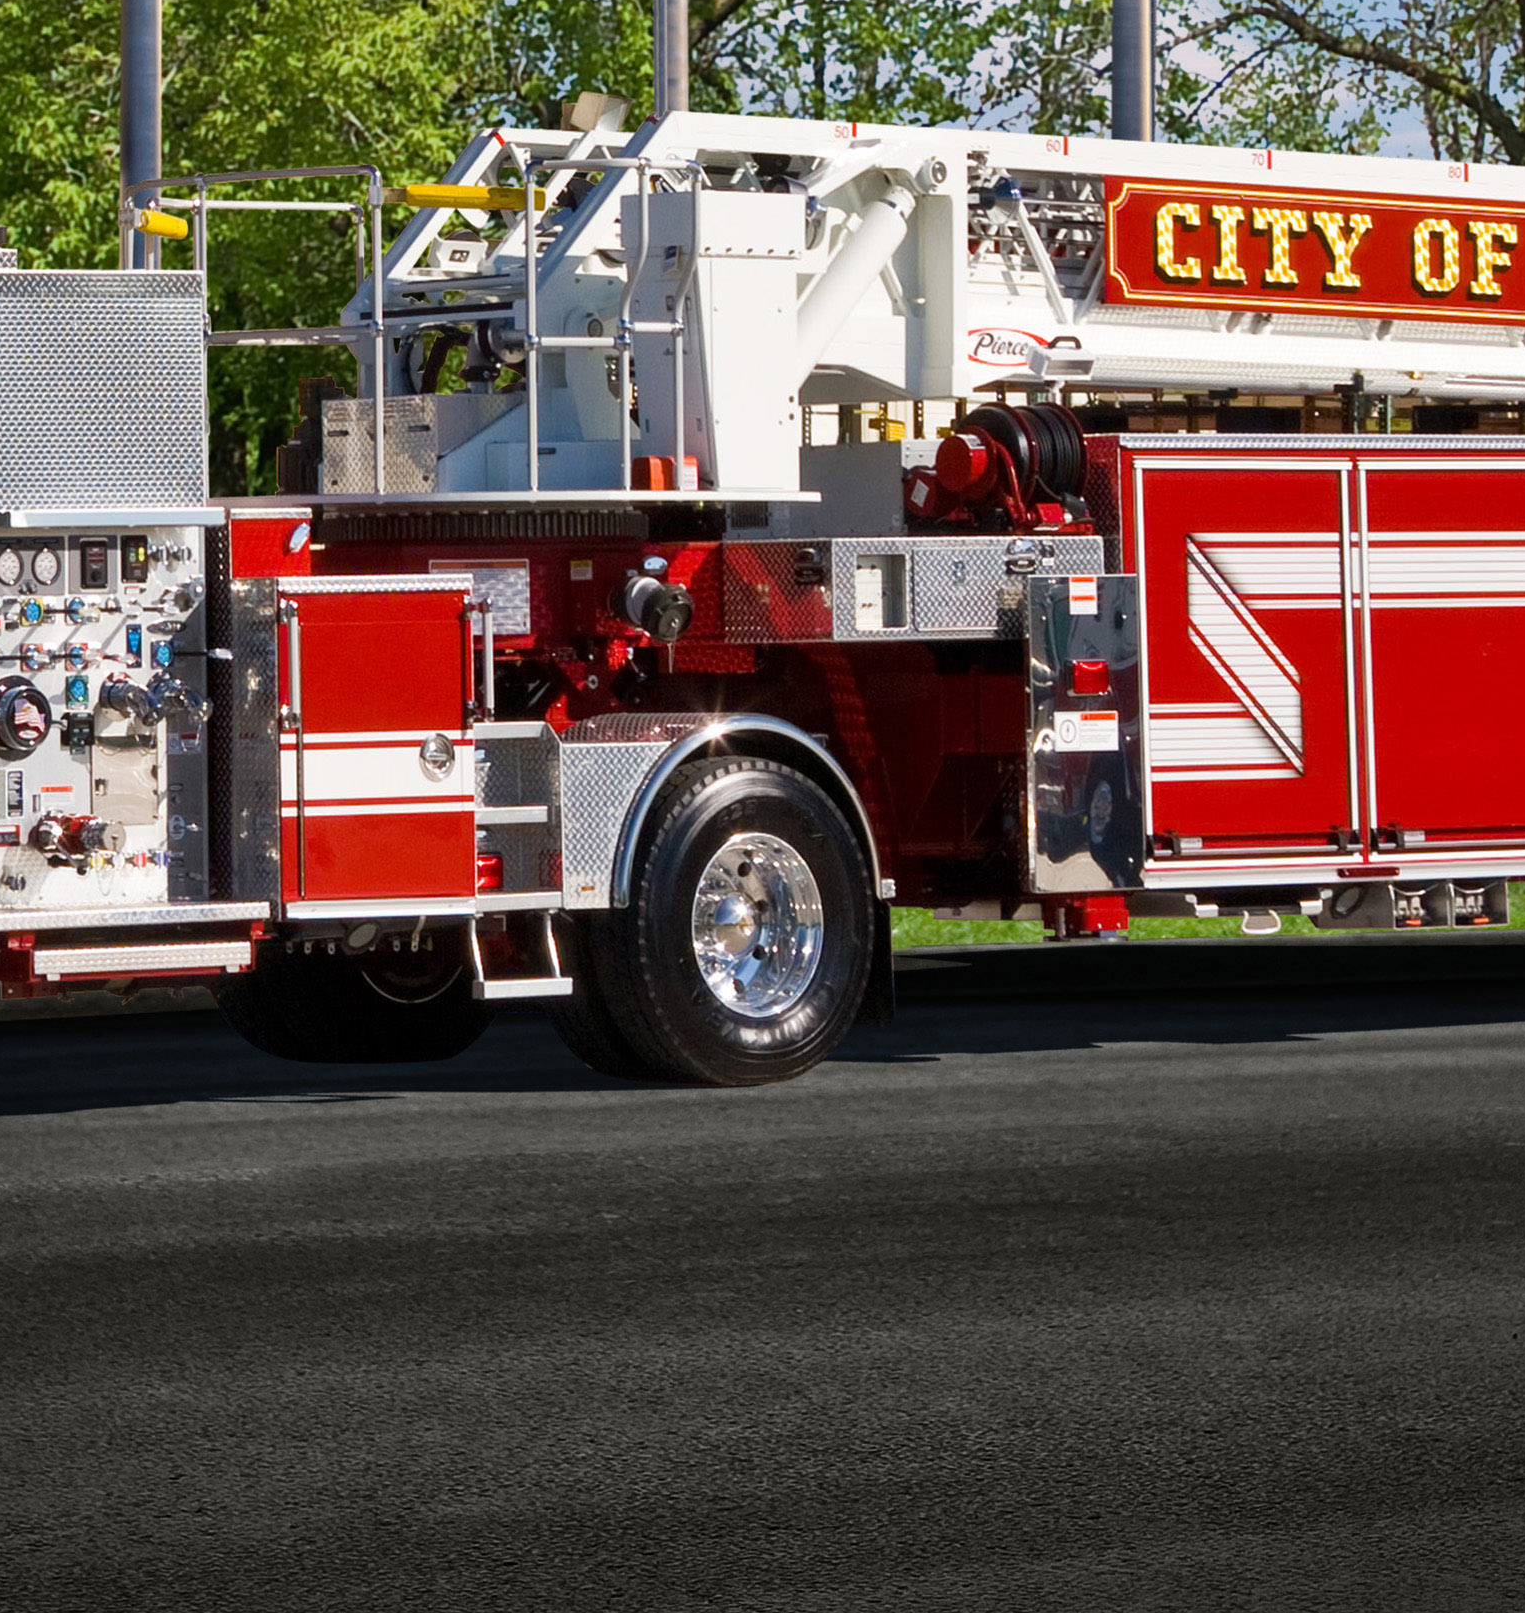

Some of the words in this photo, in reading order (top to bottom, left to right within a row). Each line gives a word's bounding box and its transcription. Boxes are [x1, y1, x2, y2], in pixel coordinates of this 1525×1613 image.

[834, 126, 850, 139] 50
[1046, 140, 1061, 153] 60
[1251, 153, 1265, 166] 70
[1448, 166, 1461, 179] 80
[1157, 202, 1372, 288] CITY
[1413, 218, 1517, 296] OF
[974, 332, 1028, 356] Pierce
